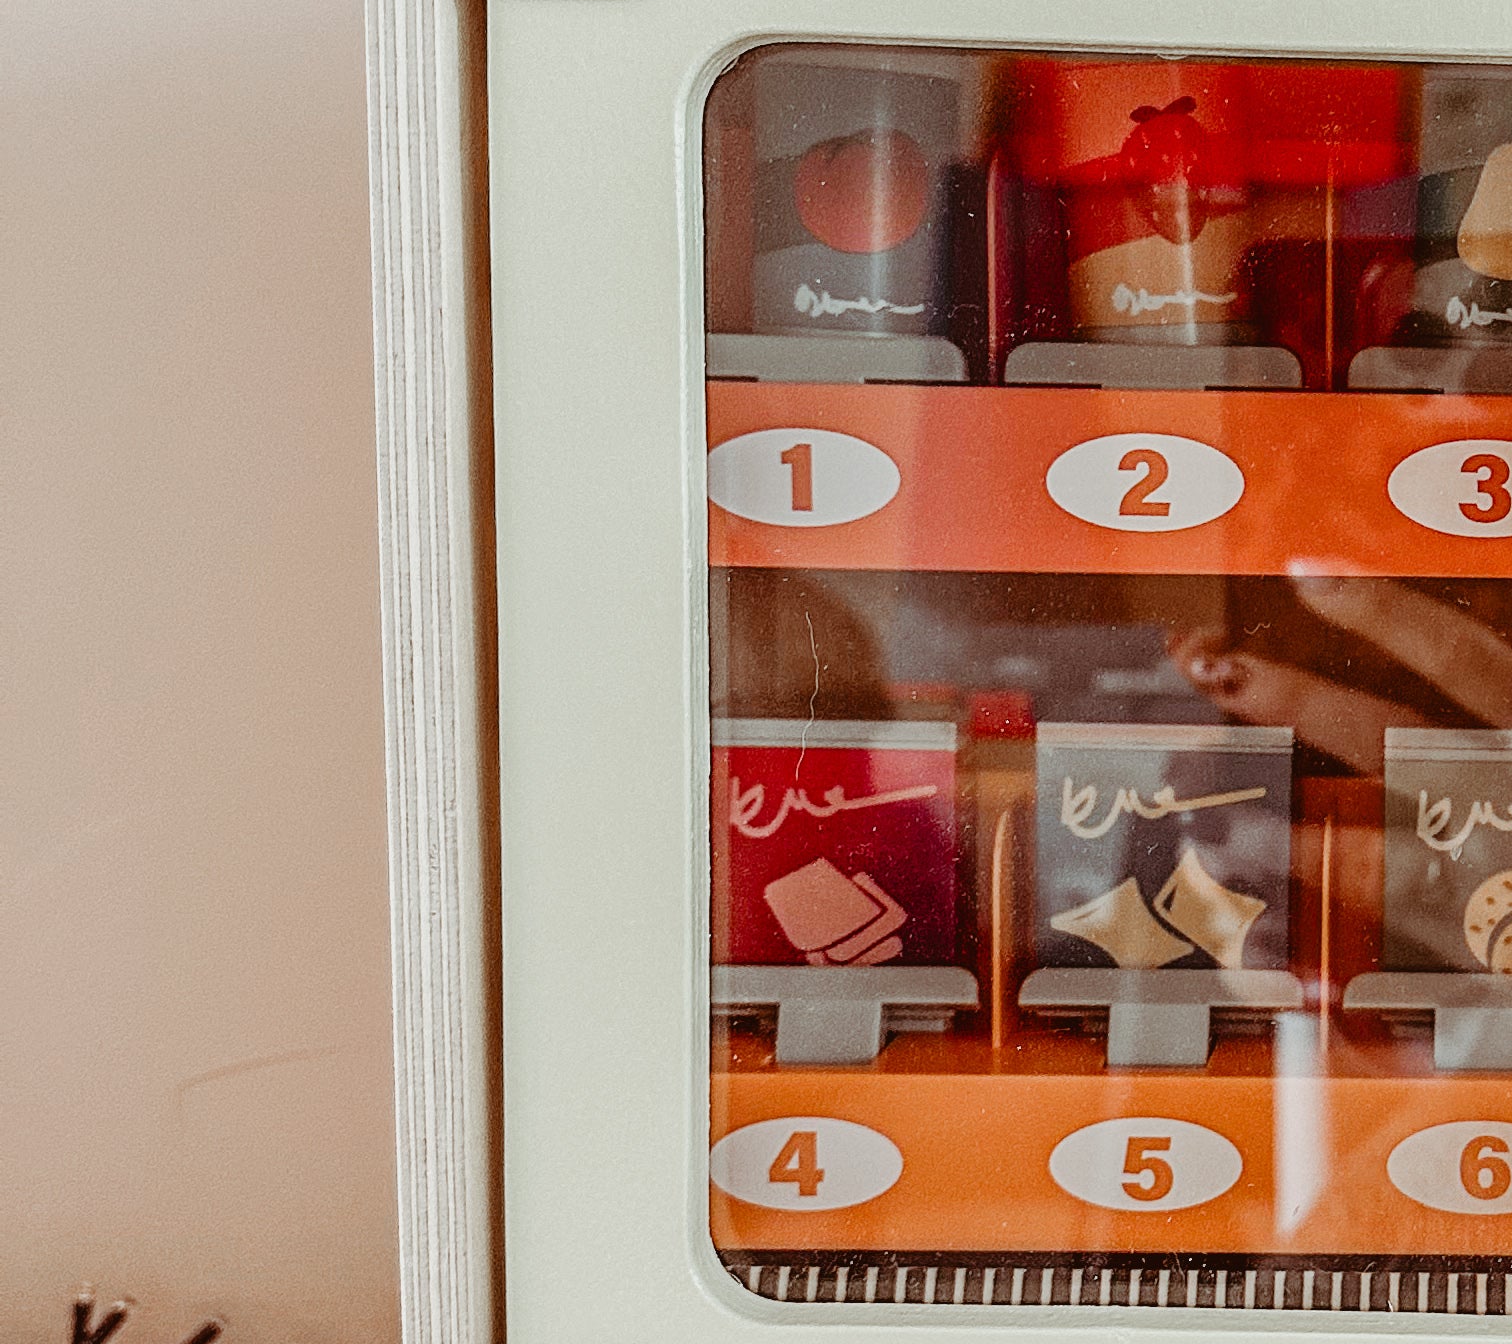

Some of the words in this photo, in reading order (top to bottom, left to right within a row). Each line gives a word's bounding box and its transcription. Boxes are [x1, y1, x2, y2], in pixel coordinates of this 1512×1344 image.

[780, 444, 815, 512] 1
[1116, 448, 1172, 517] 2
[1457, 454, 1512, 524] 3
[768, 1131, 825, 1197] 4
[1121, 1137, 1174, 1200] 5
[1458, 1136, 1511, 1200] 6
